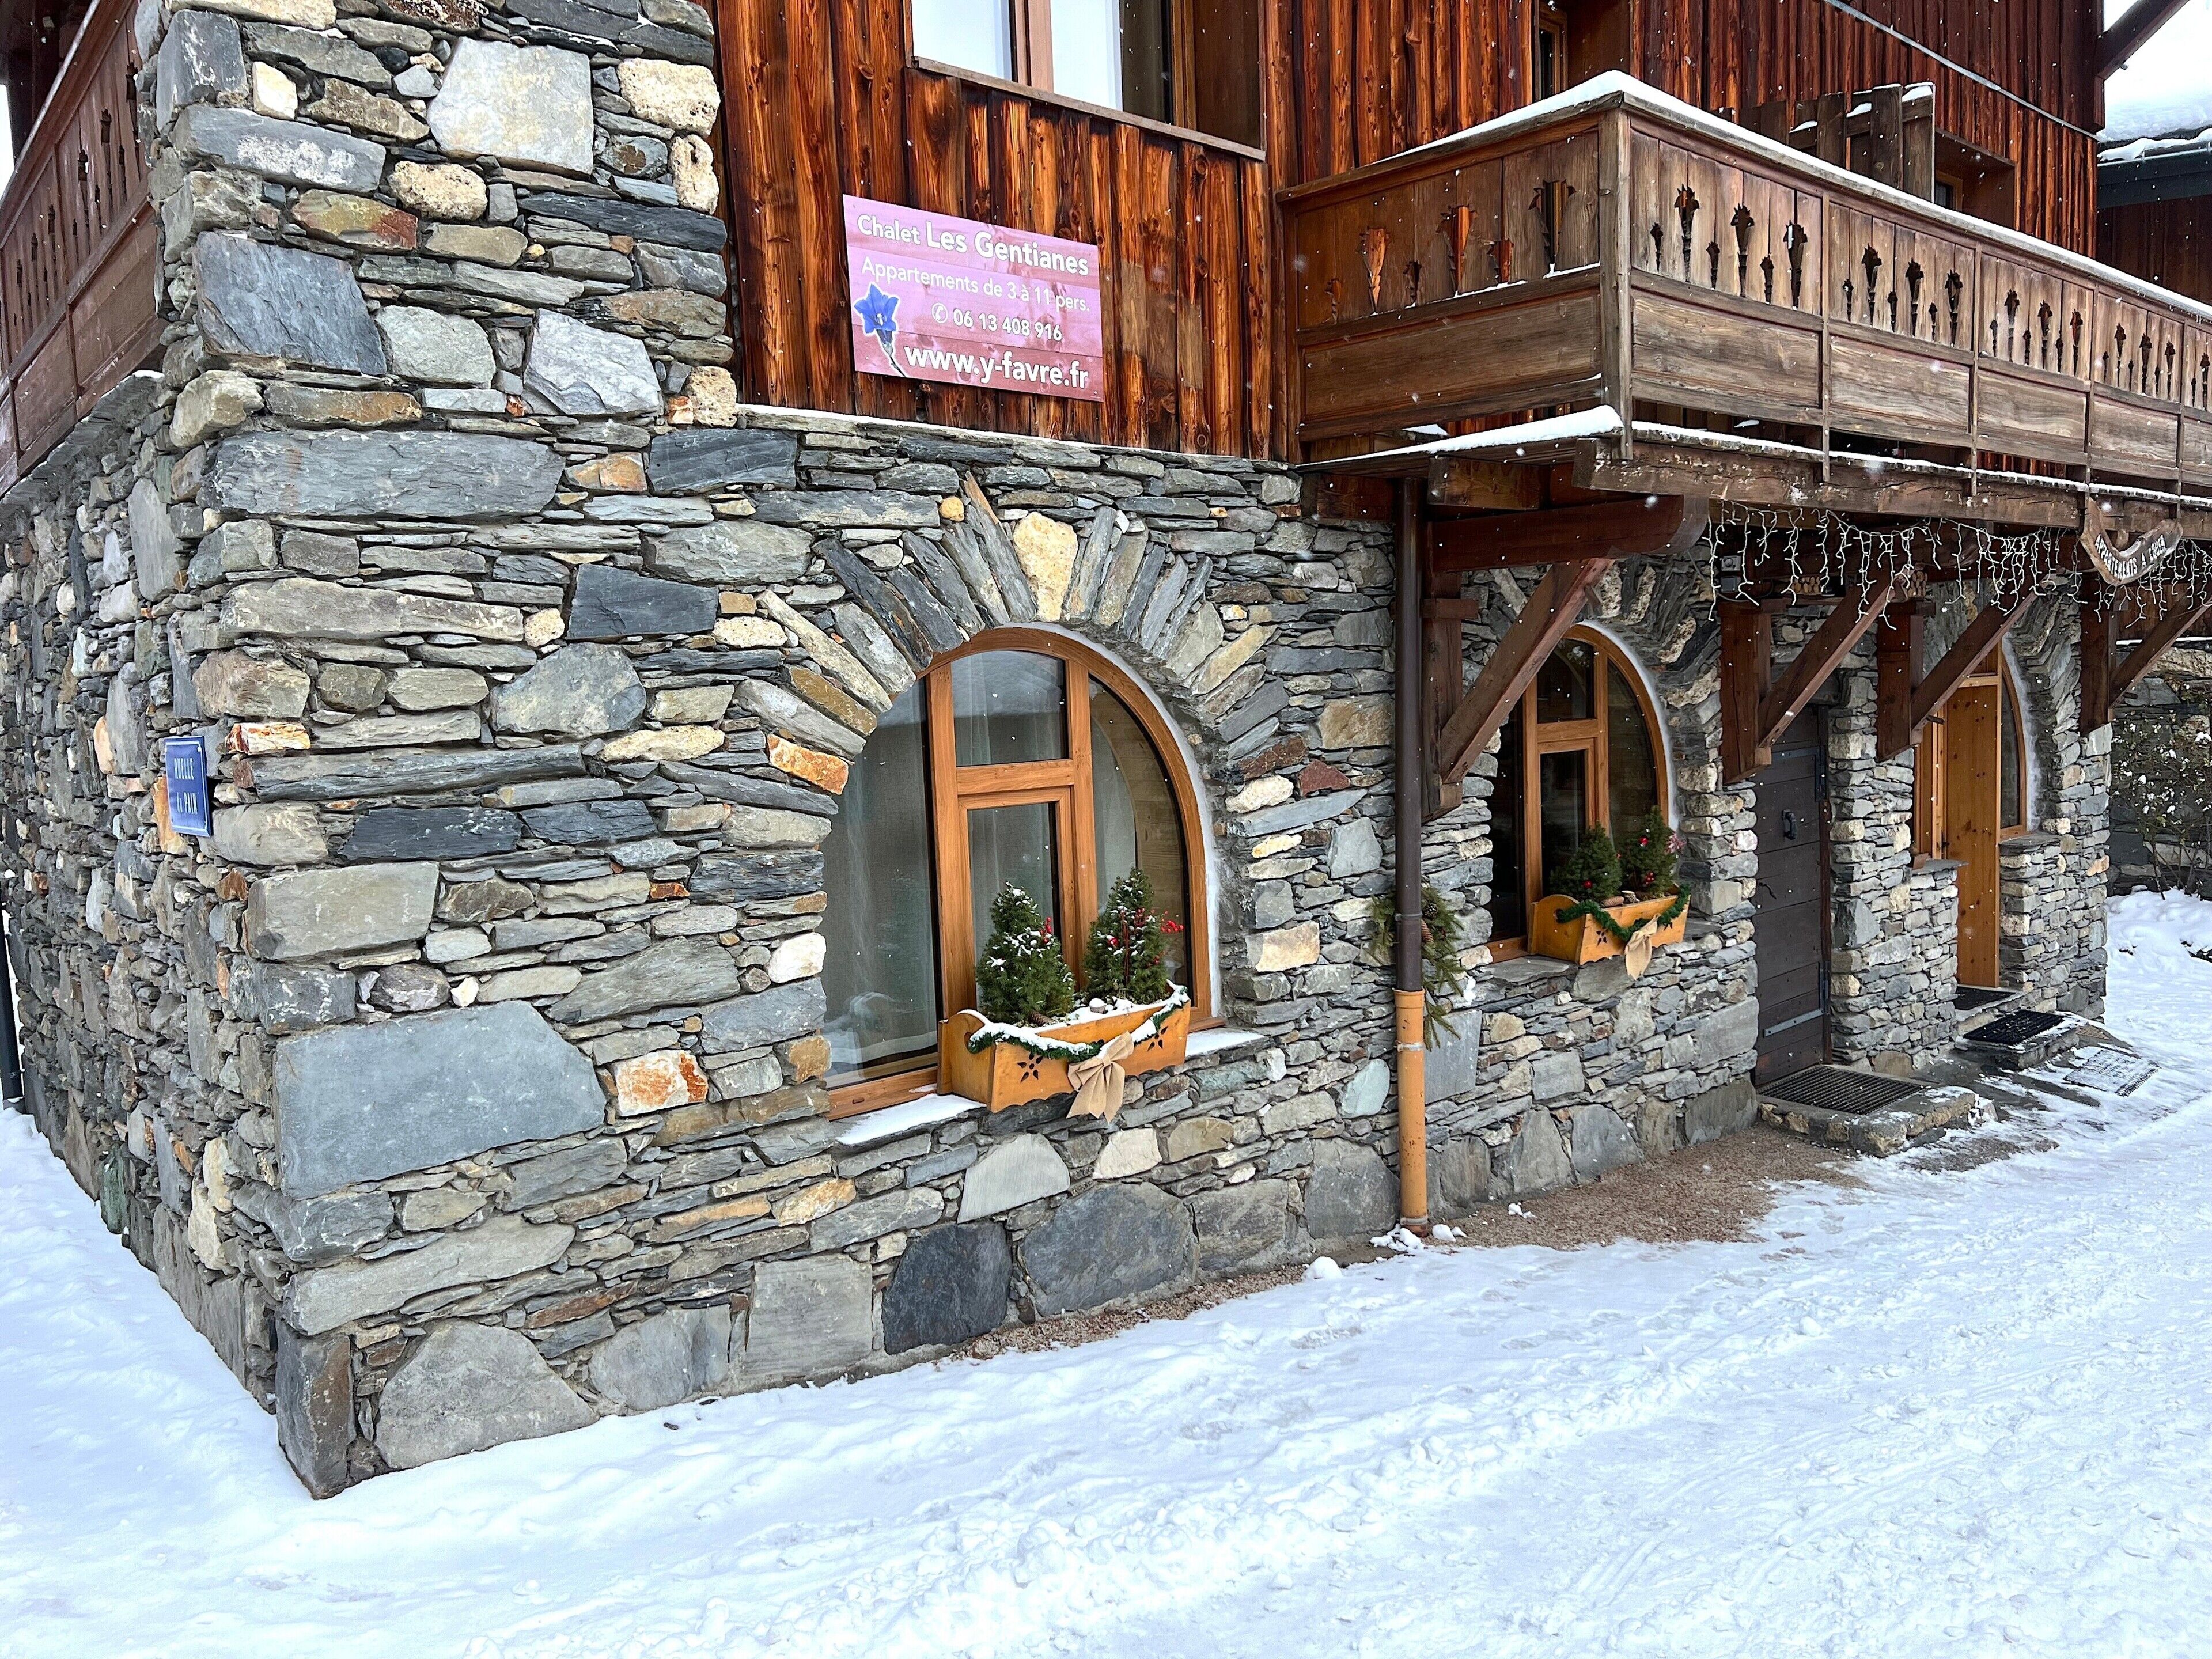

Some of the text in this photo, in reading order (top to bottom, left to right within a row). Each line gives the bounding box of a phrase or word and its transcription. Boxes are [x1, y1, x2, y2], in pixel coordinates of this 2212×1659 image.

[857, 214, 1089, 276] Chalet Les Gentianes
[862, 256, 1090, 313] Appartements de 3 à 11 pers.
[952, 309, 1063, 342] 06 13 408 916
[904, 346, 1089, 389] www.y-favre.fr
[2094, 533, 2138, 580] APPARTEMENTS
[2141, 552, 2147, 568] A
[174, 757, 194, 781] RUELLE
[183, 792, 198, 815] PAIN
